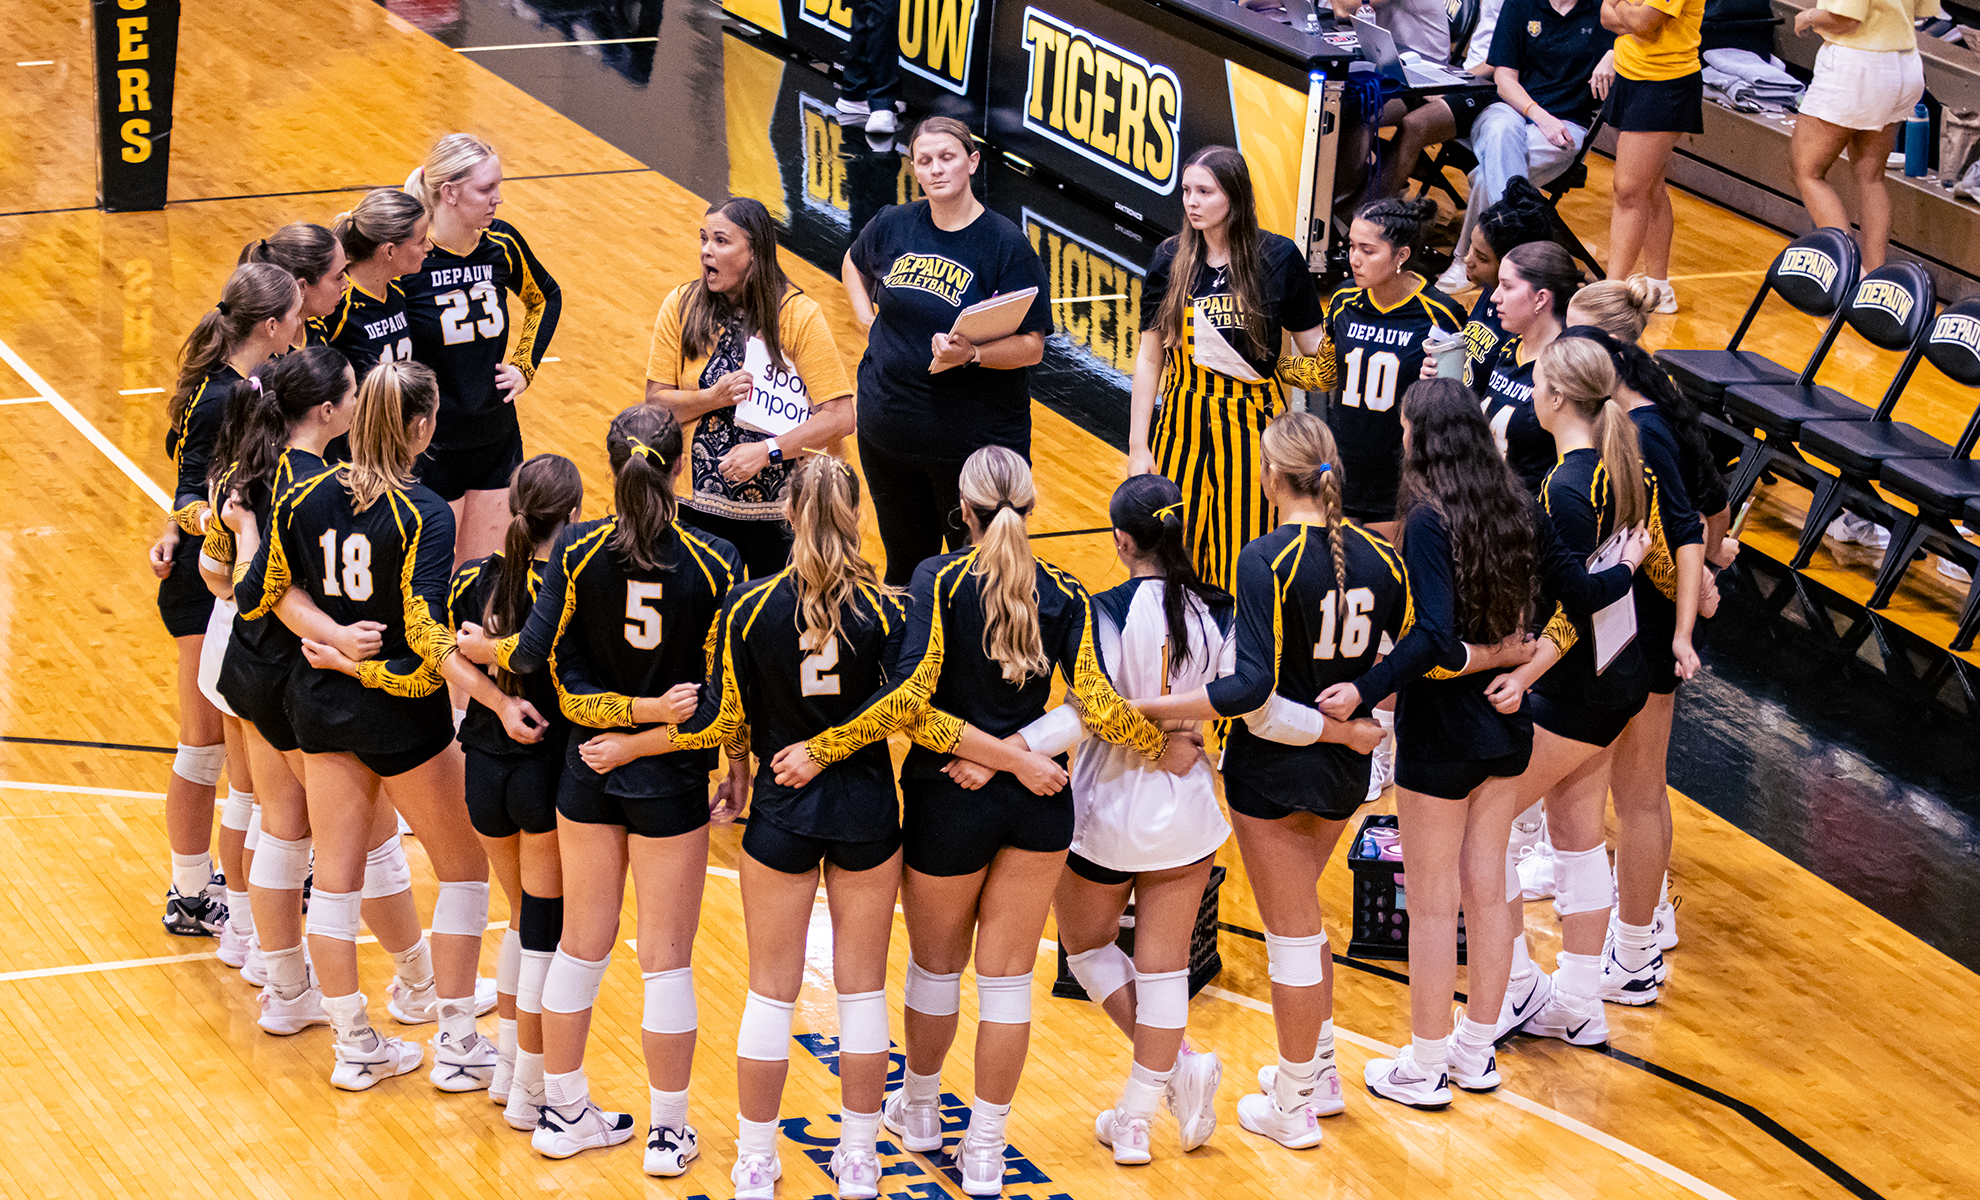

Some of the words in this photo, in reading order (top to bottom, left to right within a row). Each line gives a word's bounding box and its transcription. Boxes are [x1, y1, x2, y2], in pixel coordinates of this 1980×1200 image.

[1026, 18, 1176, 181] TIGERS
[430, 264, 493, 287] DEPAUW
[883, 272, 959, 304] VOLLEYBALL
[890, 255, 970, 291] DEPAUW
[1780, 251, 1835, 285] DEPAUW
[434, 279, 505, 346] 23
[1856, 283, 1911, 318] DEPAUW
[1346, 322, 1414, 347] DEPAUW
[1341, 347, 1400, 412] 10
[1488, 370, 1534, 402] DEPAUW
[319, 528, 374, 601] 18
[624, 579, 663, 650] 5
[1313, 586, 1375, 660] 16
[799, 628, 841, 697] 2
